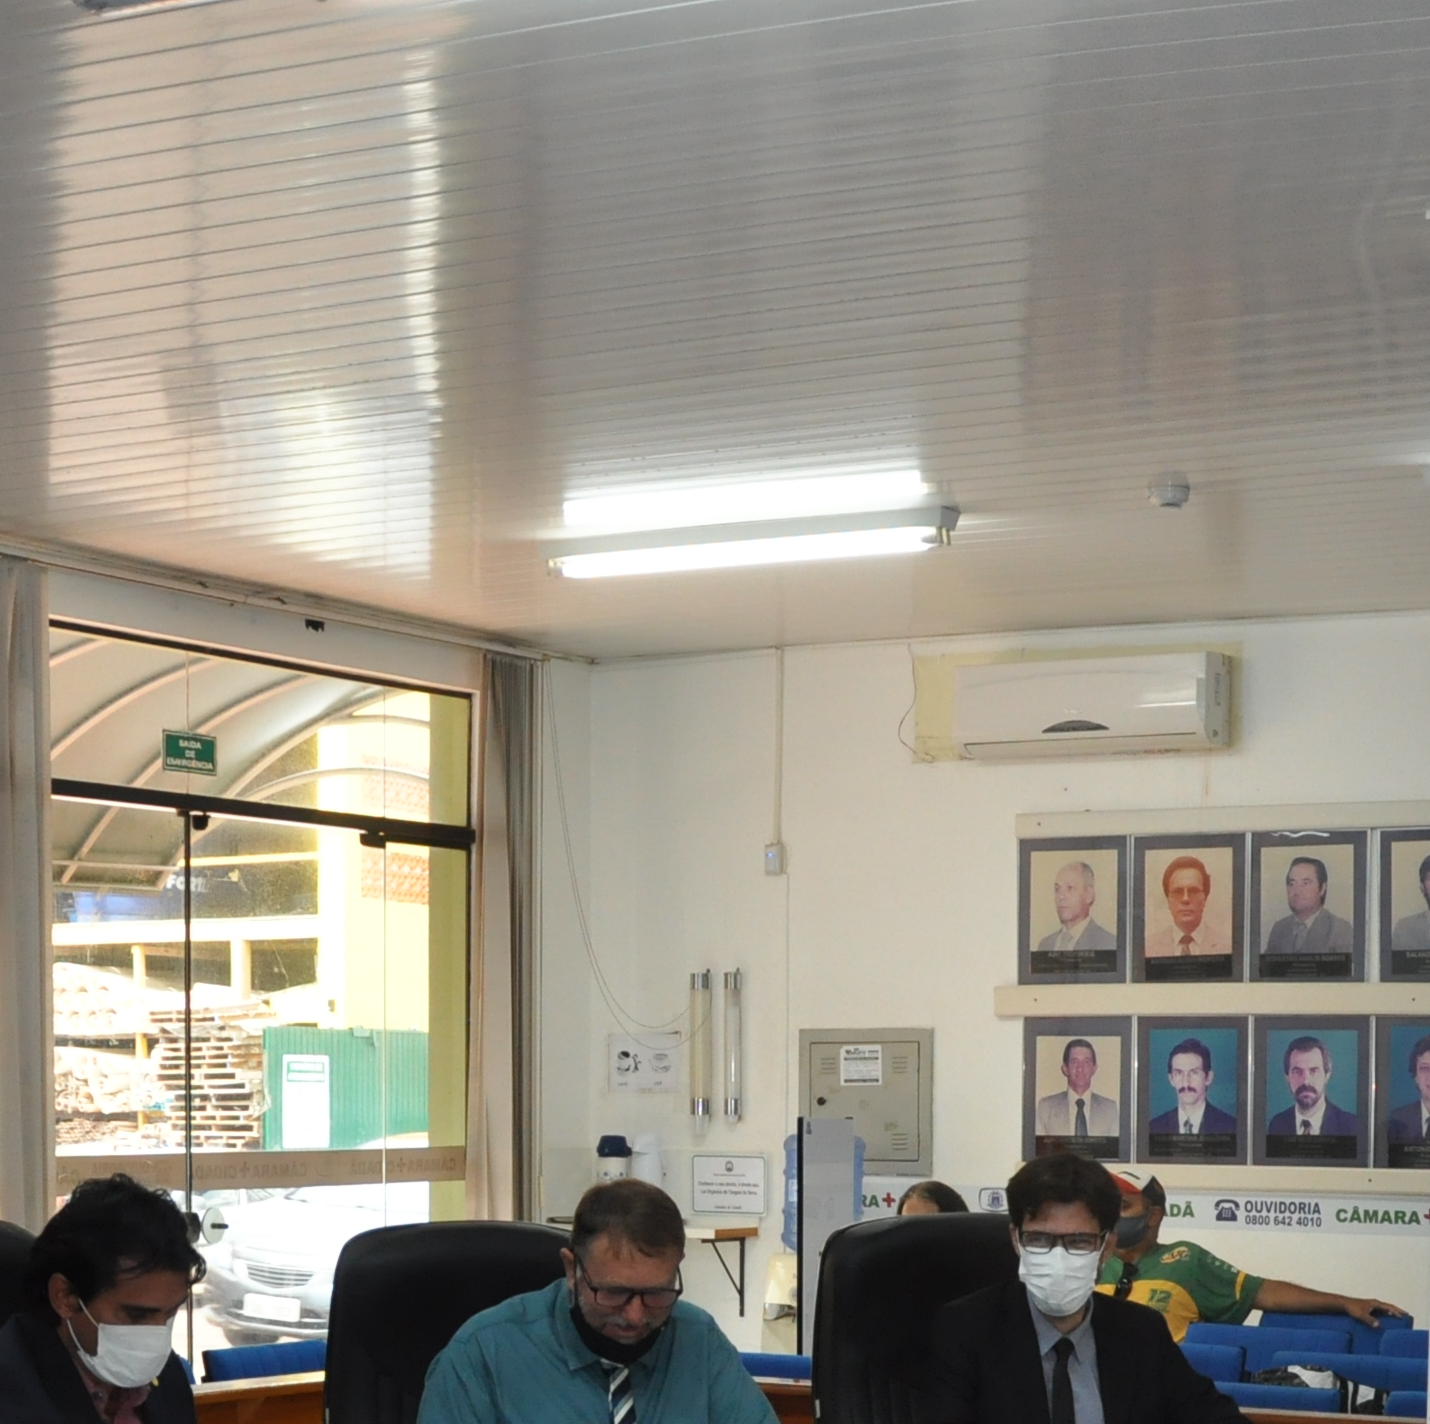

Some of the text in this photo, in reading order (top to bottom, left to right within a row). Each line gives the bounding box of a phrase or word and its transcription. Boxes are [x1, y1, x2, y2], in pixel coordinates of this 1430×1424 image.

[1244, 1199, 1322, 1216] OUVIDORIA
[1335, 1205, 1422, 1225] CÂMARA
[1244, 1215, 1323, 1228] 0800 642 4010
